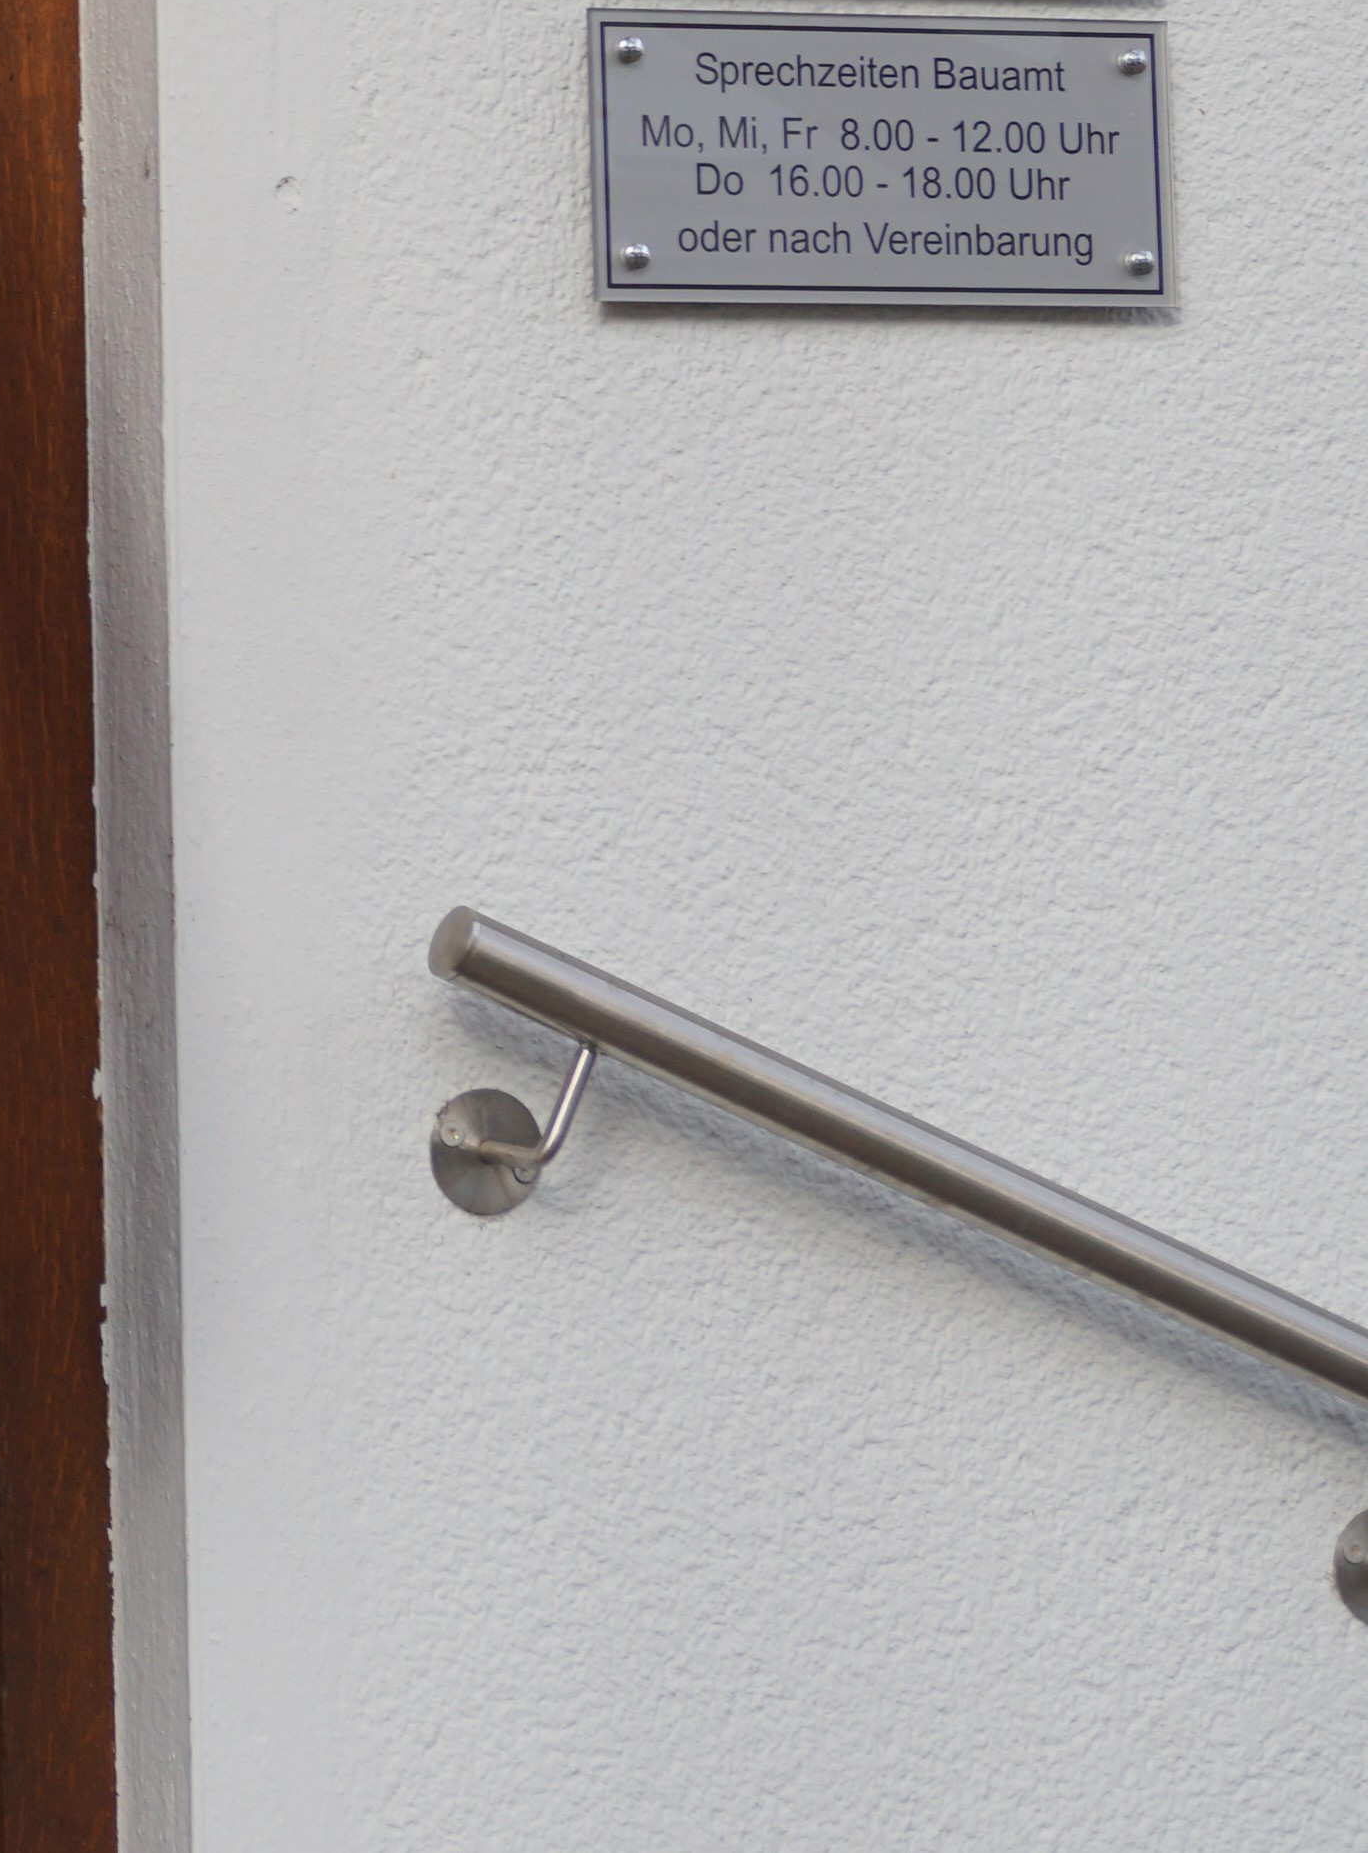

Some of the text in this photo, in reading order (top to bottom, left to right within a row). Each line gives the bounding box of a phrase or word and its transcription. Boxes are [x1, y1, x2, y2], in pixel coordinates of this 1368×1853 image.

[695, 51, 1066, 94] Sprechzeiten Bauamt
[641, 114, 704, 153] Mo,
[719, 115, 767, 154] Mi,
[782, 116, 819, 150] Fr
[840, 117, 914, 152] 8.00
[953, 120, 1046, 154] 12.00
[1059, 122, 1120, 155] Uhr
[696, 162, 744, 196] Do
[770, 163, 864, 198] 16.00
[902, 166, 996, 200] 18.00
[1009, 167, 1071, 201] Uhr
[678, 219, 1093, 266] oder nach Vereinbarung
